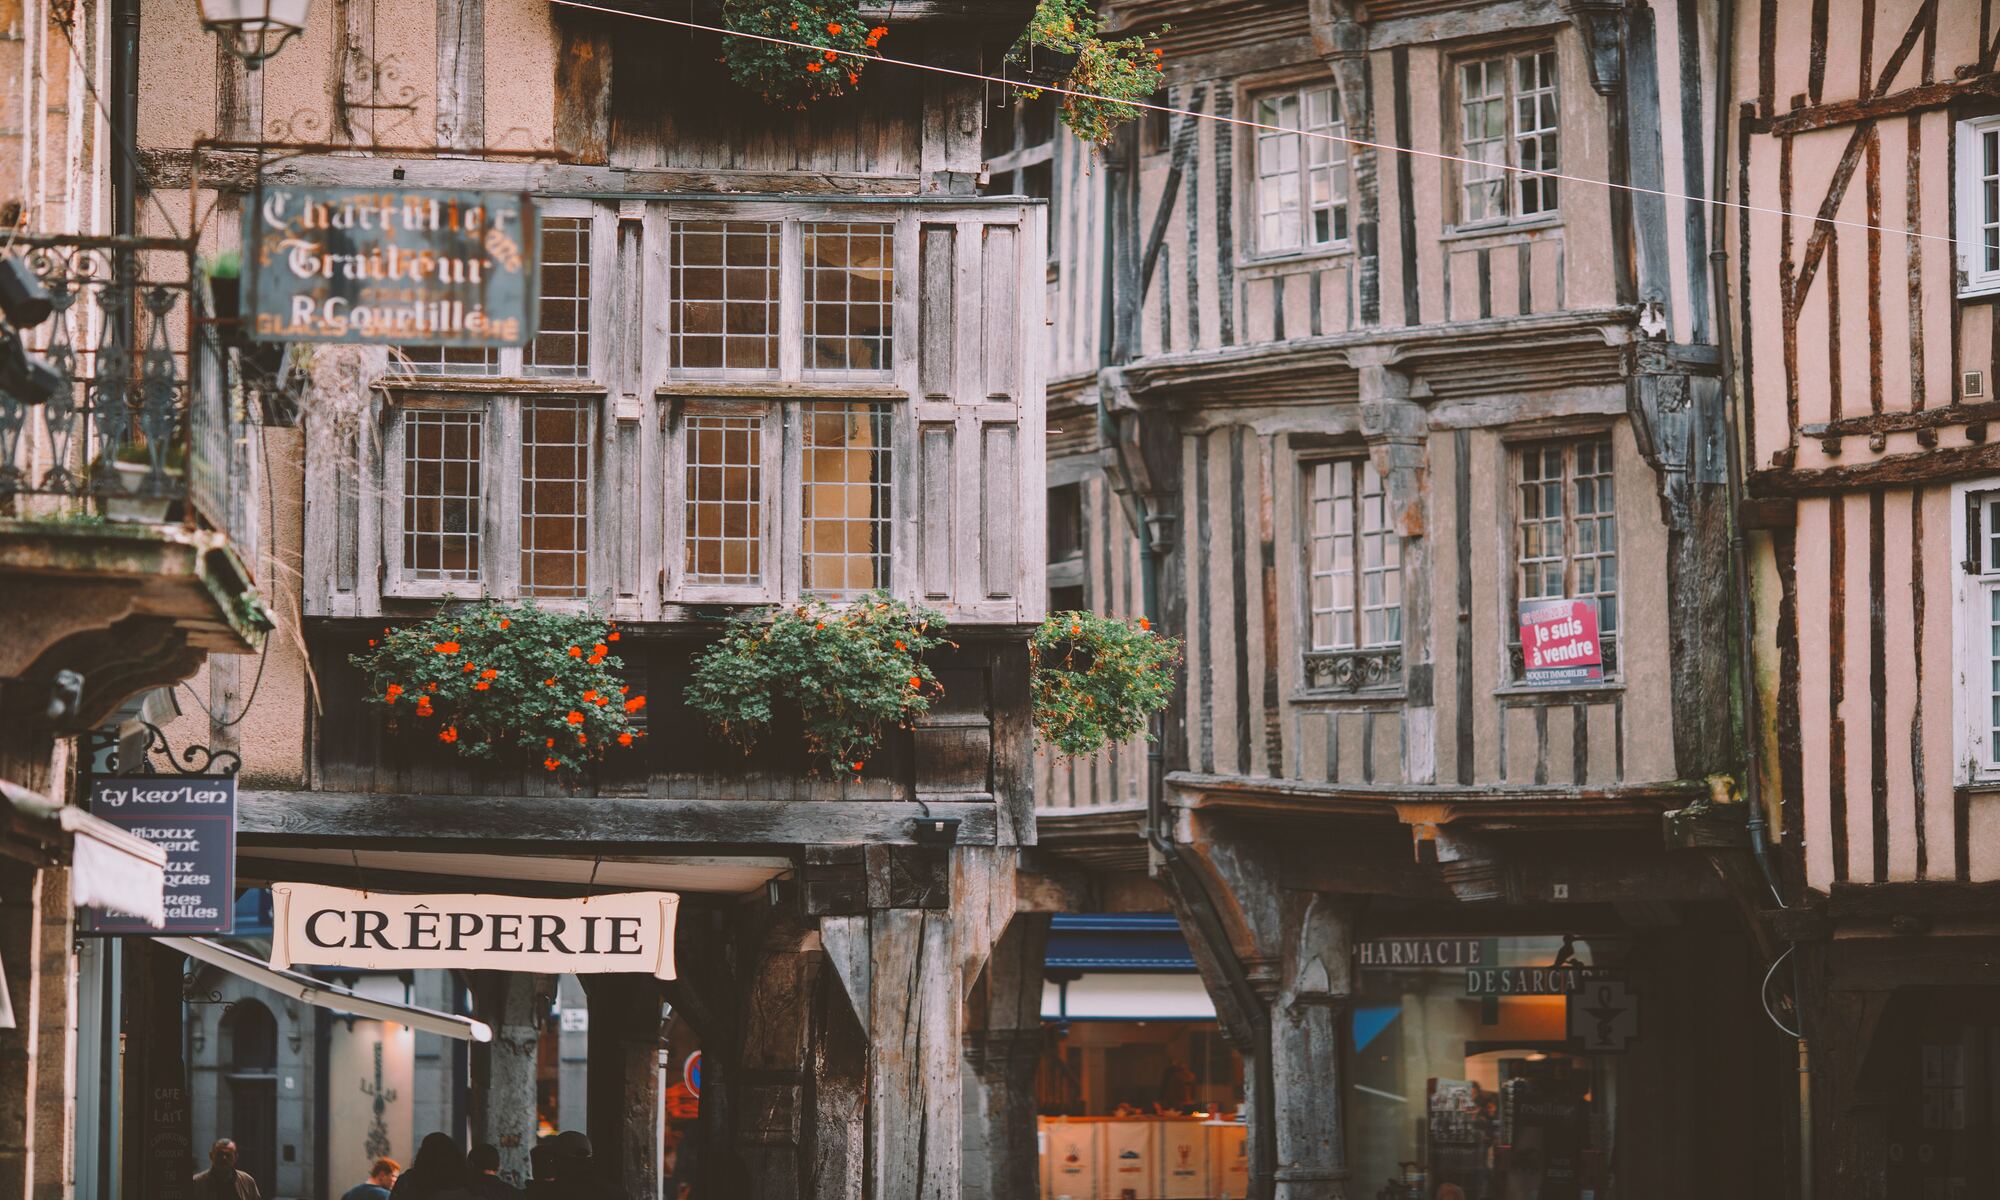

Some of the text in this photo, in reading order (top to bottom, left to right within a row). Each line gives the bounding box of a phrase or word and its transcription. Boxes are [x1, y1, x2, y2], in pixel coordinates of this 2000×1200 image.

[1551, 616, 1583, 641] suis
[1533, 638, 1594, 667] à vendre
[101, 787, 128, 807] ty
[304, 903, 643, 955] CRÊPERIE
[1352, 941, 1481, 964] HARMACIE
